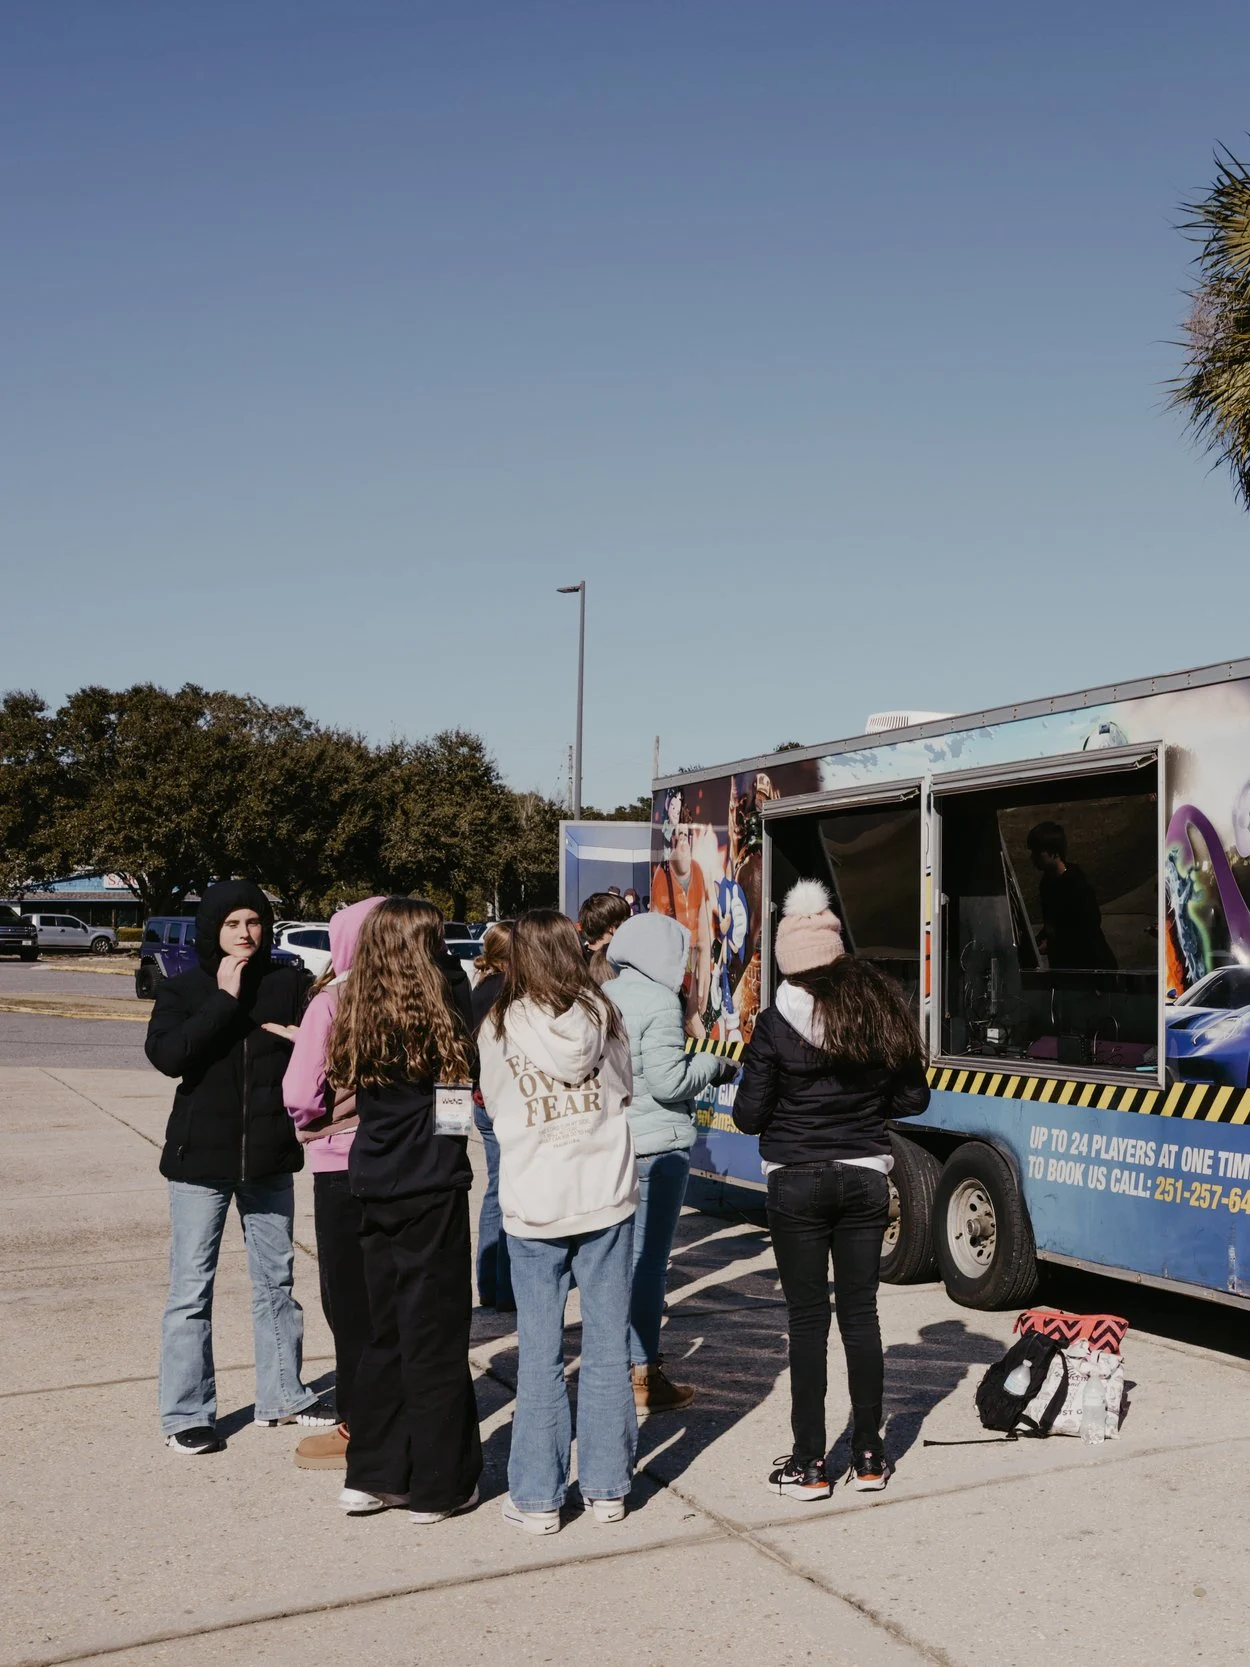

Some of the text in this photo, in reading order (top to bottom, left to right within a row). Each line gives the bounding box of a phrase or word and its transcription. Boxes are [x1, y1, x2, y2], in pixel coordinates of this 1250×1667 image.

[525, 1092, 602, 1128] FEAR
[1029, 1126, 1048, 1149] UP
[1051, 1128, 1068, 1153] TO
[1070, 1131, 1089, 1156] 24
[1091, 1134, 1156, 1167] PLAYERS
[1158, 1143, 1178, 1169] AT
[1181, 1146, 1213, 1176] ONE
[1028, 1155, 1045, 1180] TO
[1047, 1158, 1086, 1187] BOOK
[1087, 1165, 1107, 1191] US
[1110, 1168, 1151, 1198] CALL:
